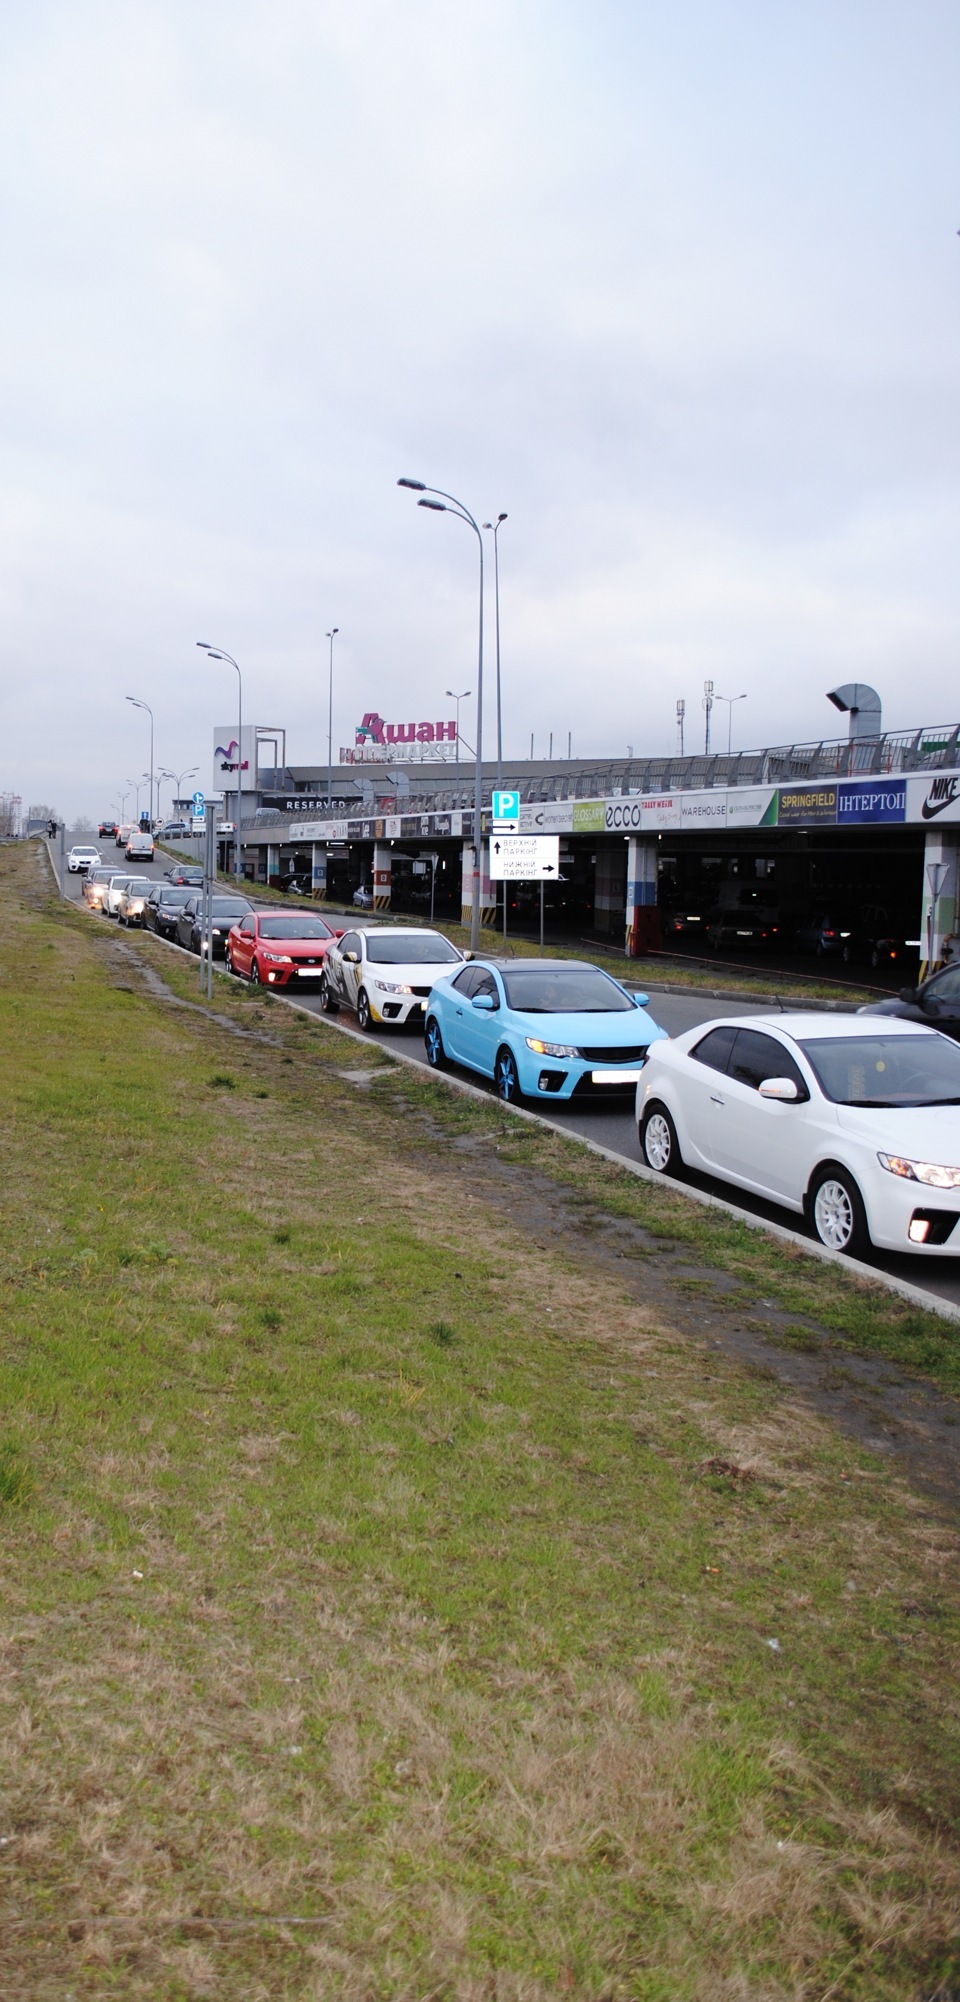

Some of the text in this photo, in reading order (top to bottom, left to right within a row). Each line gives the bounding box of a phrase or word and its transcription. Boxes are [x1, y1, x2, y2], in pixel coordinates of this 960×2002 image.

[355, 713, 456, 743] Ашан
[929, 777, 959, 801] NIKE
[286, 801, 346, 810] RESERVED
[499, 793, 515, 817] P
[781, 792, 836, 809] SPRINGFIELD
[838, 792, 906, 812] ІНТЕРТОП
[574, 807, 605, 823] GLOSSARY
[606, 804, 641, 828] ecco
[681, 805, 726, 817] WAREHOUSE
[503, 839, 537, 847] ВЕРХНІЙ
[503, 847, 538, 855] ПАРКІНГ
[503, 860, 536, 868] НИЖНІЙ
[503, 869, 538, 877] ПАРКІНГ
